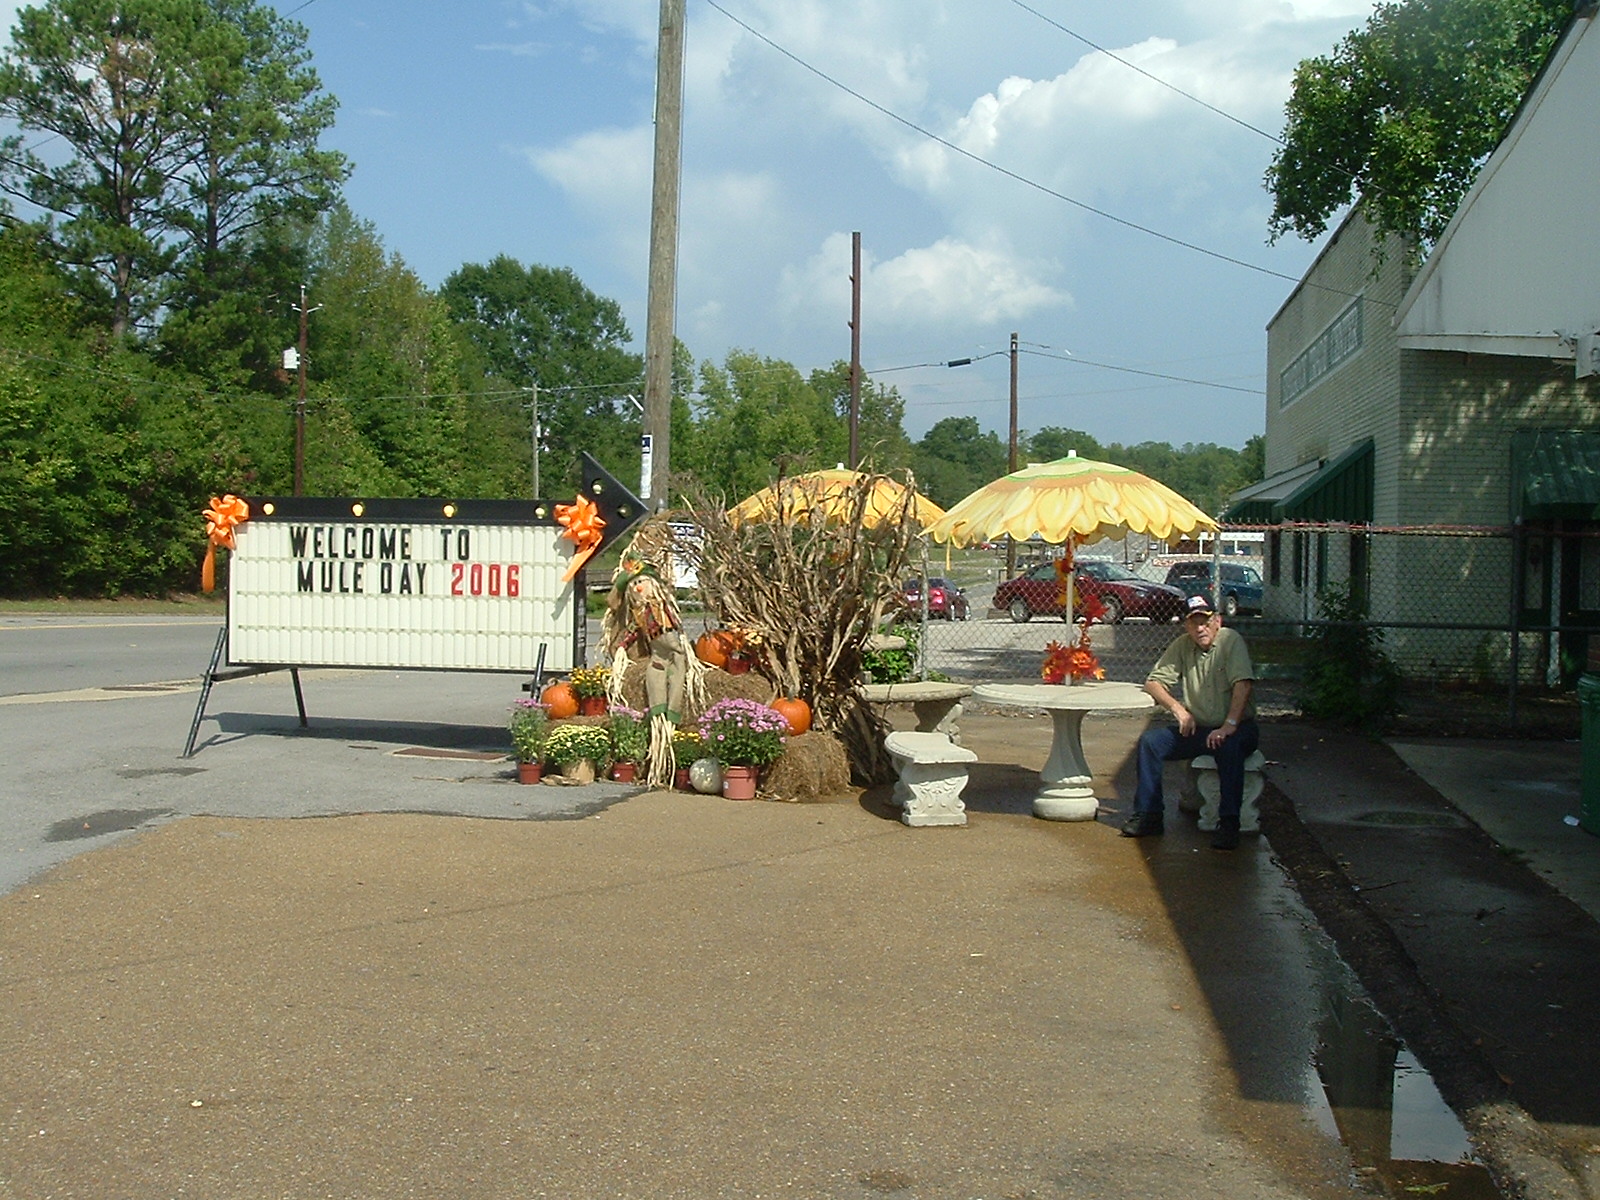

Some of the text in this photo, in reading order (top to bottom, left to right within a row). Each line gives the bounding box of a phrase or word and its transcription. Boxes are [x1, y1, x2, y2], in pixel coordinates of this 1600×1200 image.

[290, 526, 470, 560] WELCOME TO
[298, 561, 519, 597] MULE DAY 2006
